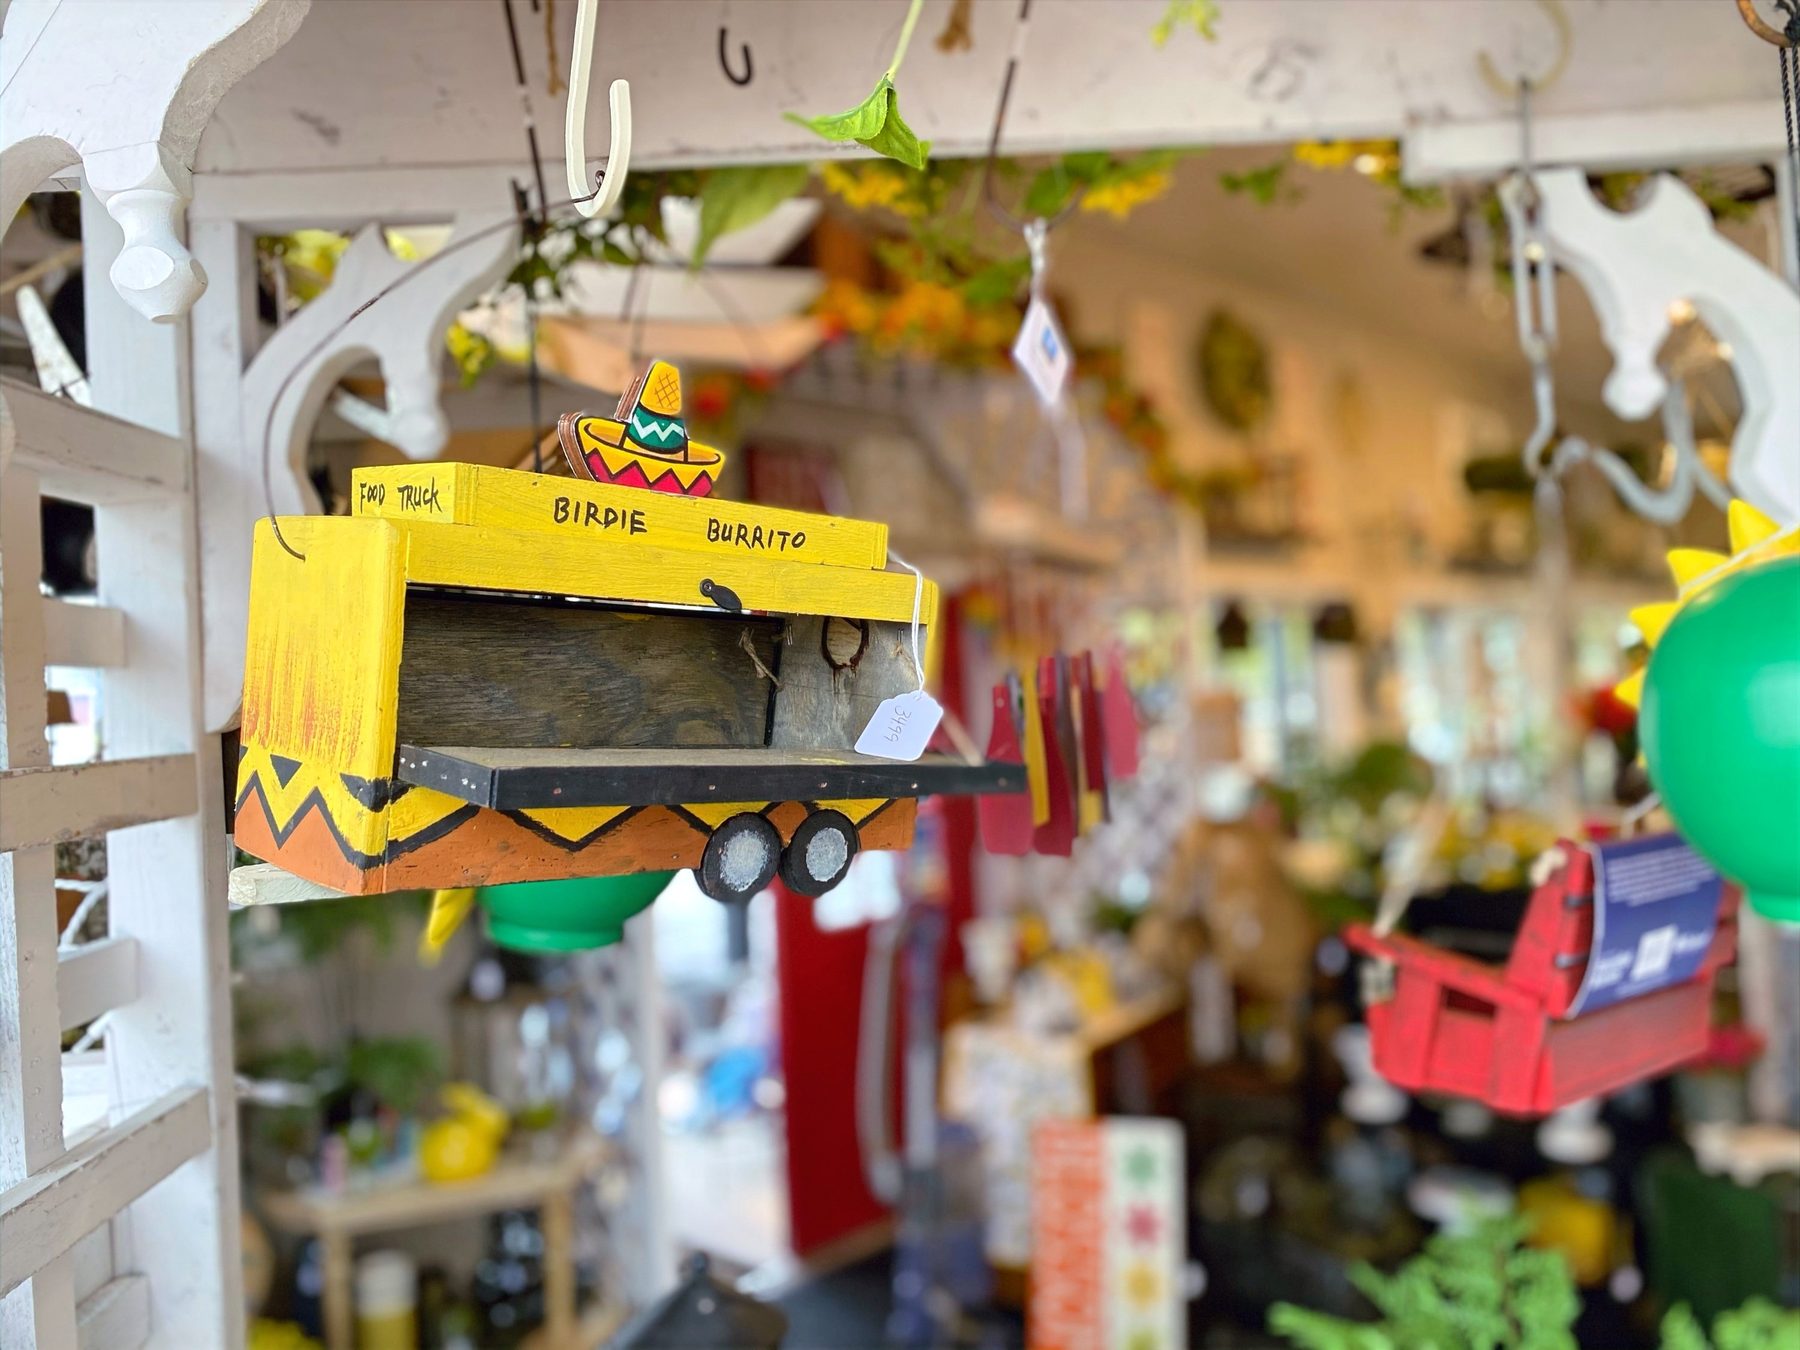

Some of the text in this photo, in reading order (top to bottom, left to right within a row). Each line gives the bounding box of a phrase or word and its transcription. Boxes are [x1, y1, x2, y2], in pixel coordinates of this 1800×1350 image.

[359, 476, 443, 514] FOOD TRUCK
[553, 496, 806, 552] BIRDIE BURRITO
